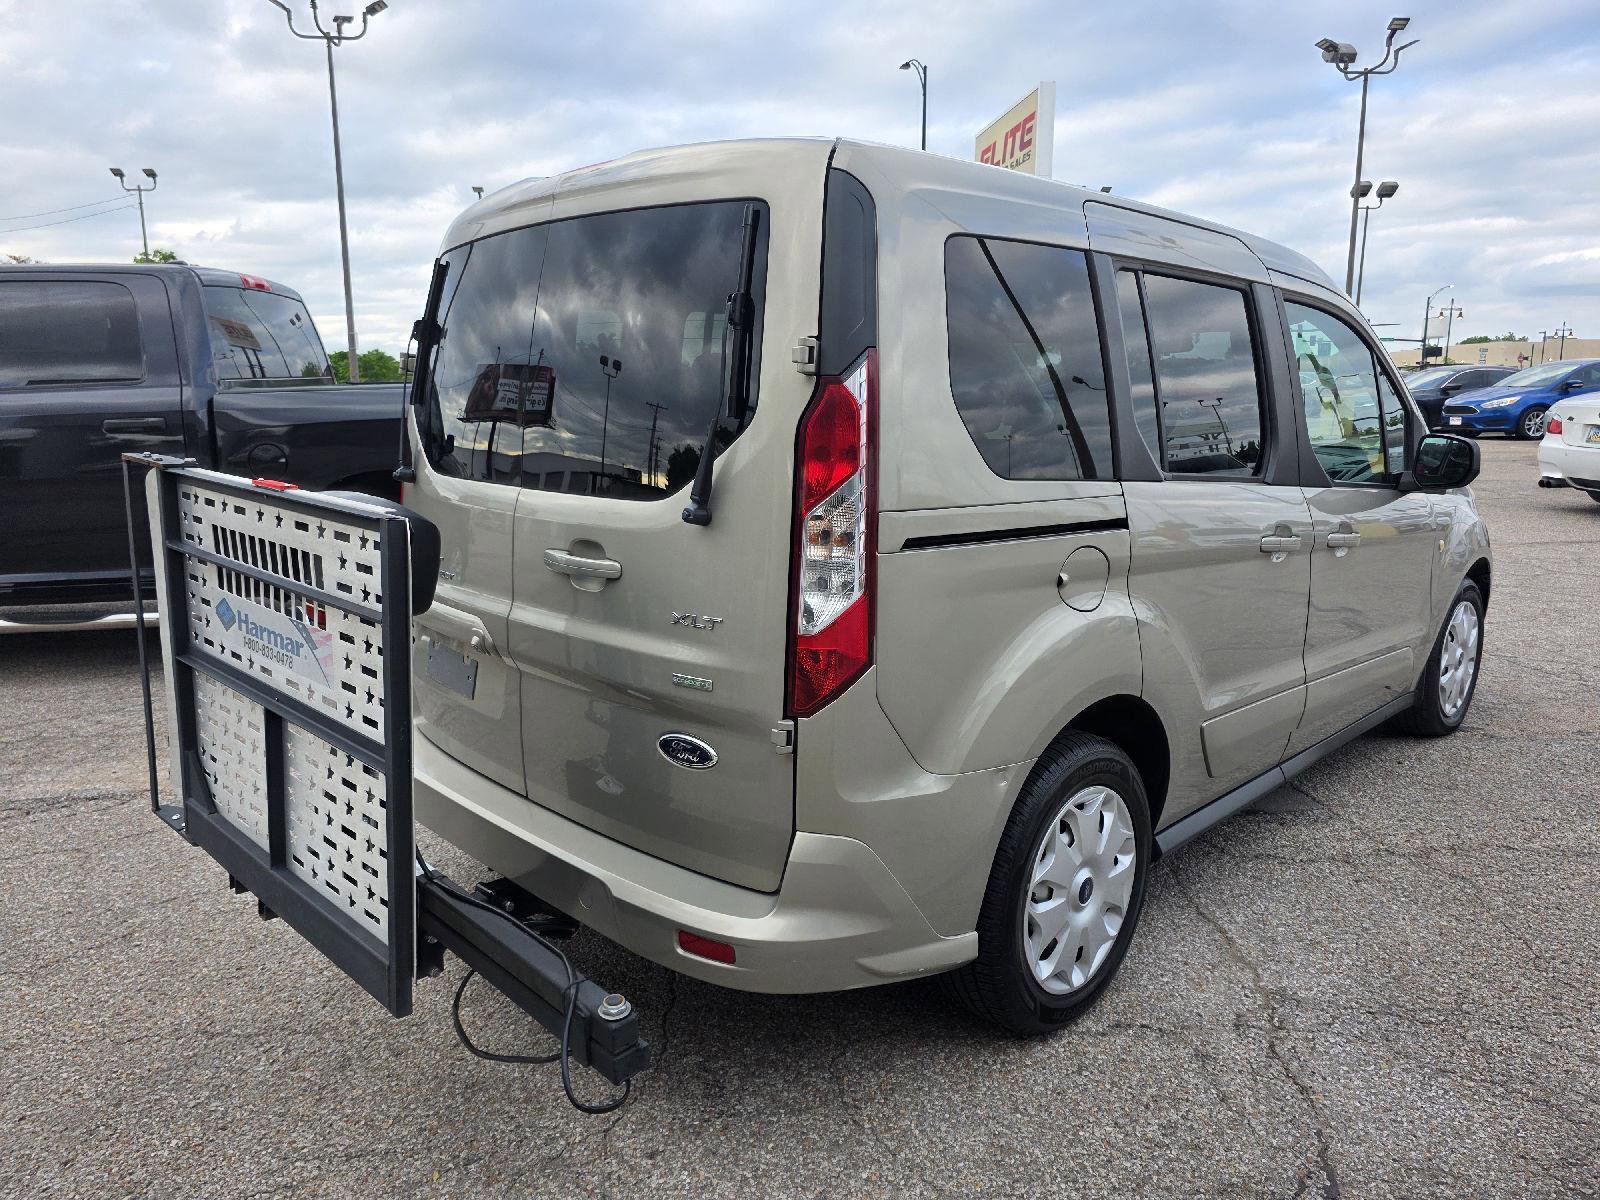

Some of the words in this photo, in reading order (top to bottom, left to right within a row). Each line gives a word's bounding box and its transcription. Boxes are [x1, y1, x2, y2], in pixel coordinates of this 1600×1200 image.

[1009, 149, 1032, 170] SALES
[670, 611, 724, 631] XLT
[237, 609, 305, 658] Harmar
[243, 635, 294, 670] 1-800-833-0478
[669, 740, 701, 763] Ford
